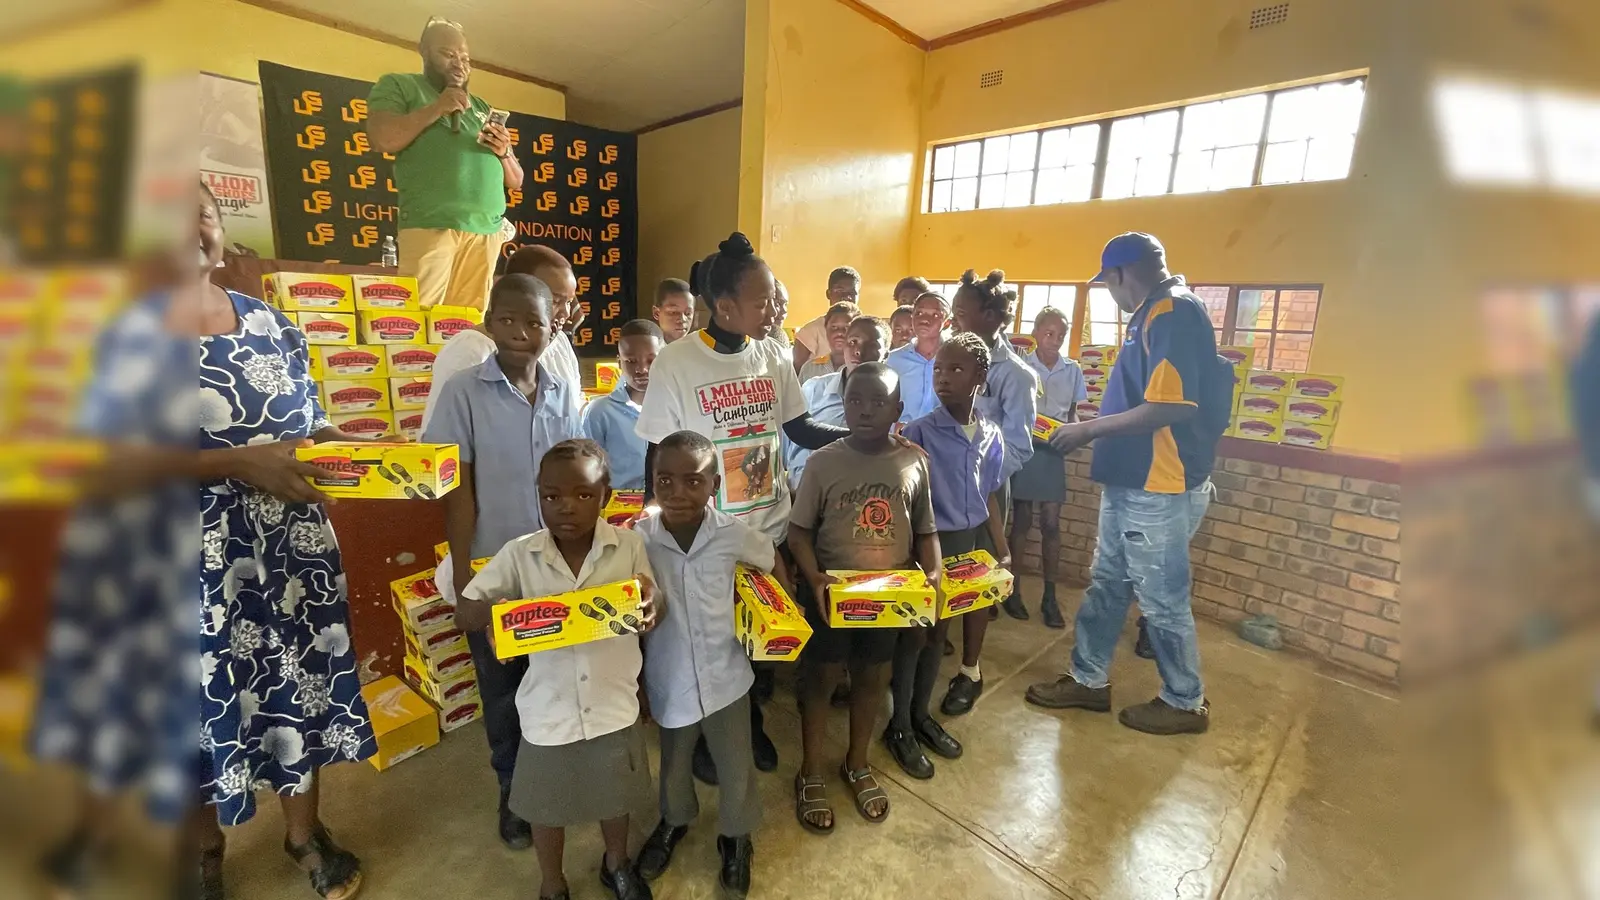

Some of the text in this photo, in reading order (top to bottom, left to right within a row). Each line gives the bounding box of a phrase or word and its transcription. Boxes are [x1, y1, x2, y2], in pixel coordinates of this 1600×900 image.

[203, 173, 255, 192] LION
[214, 187, 257, 201] SHOES
[514, 221, 592, 241] NDATION
[289, 284, 346, 299] Raptees
[360, 285, 412, 299] Raptees
[370, 319, 421, 331] Raptees
[698, 379, 774, 404] 1 MILLION
[703, 392, 776, 413] SCHOOL SHOES
[712, 401, 773, 423] Campaign
[312, 460, 371, 477] aptees
[836, 601, 886, 613] Raptees
[501, 605, 571, 628] Raptees
